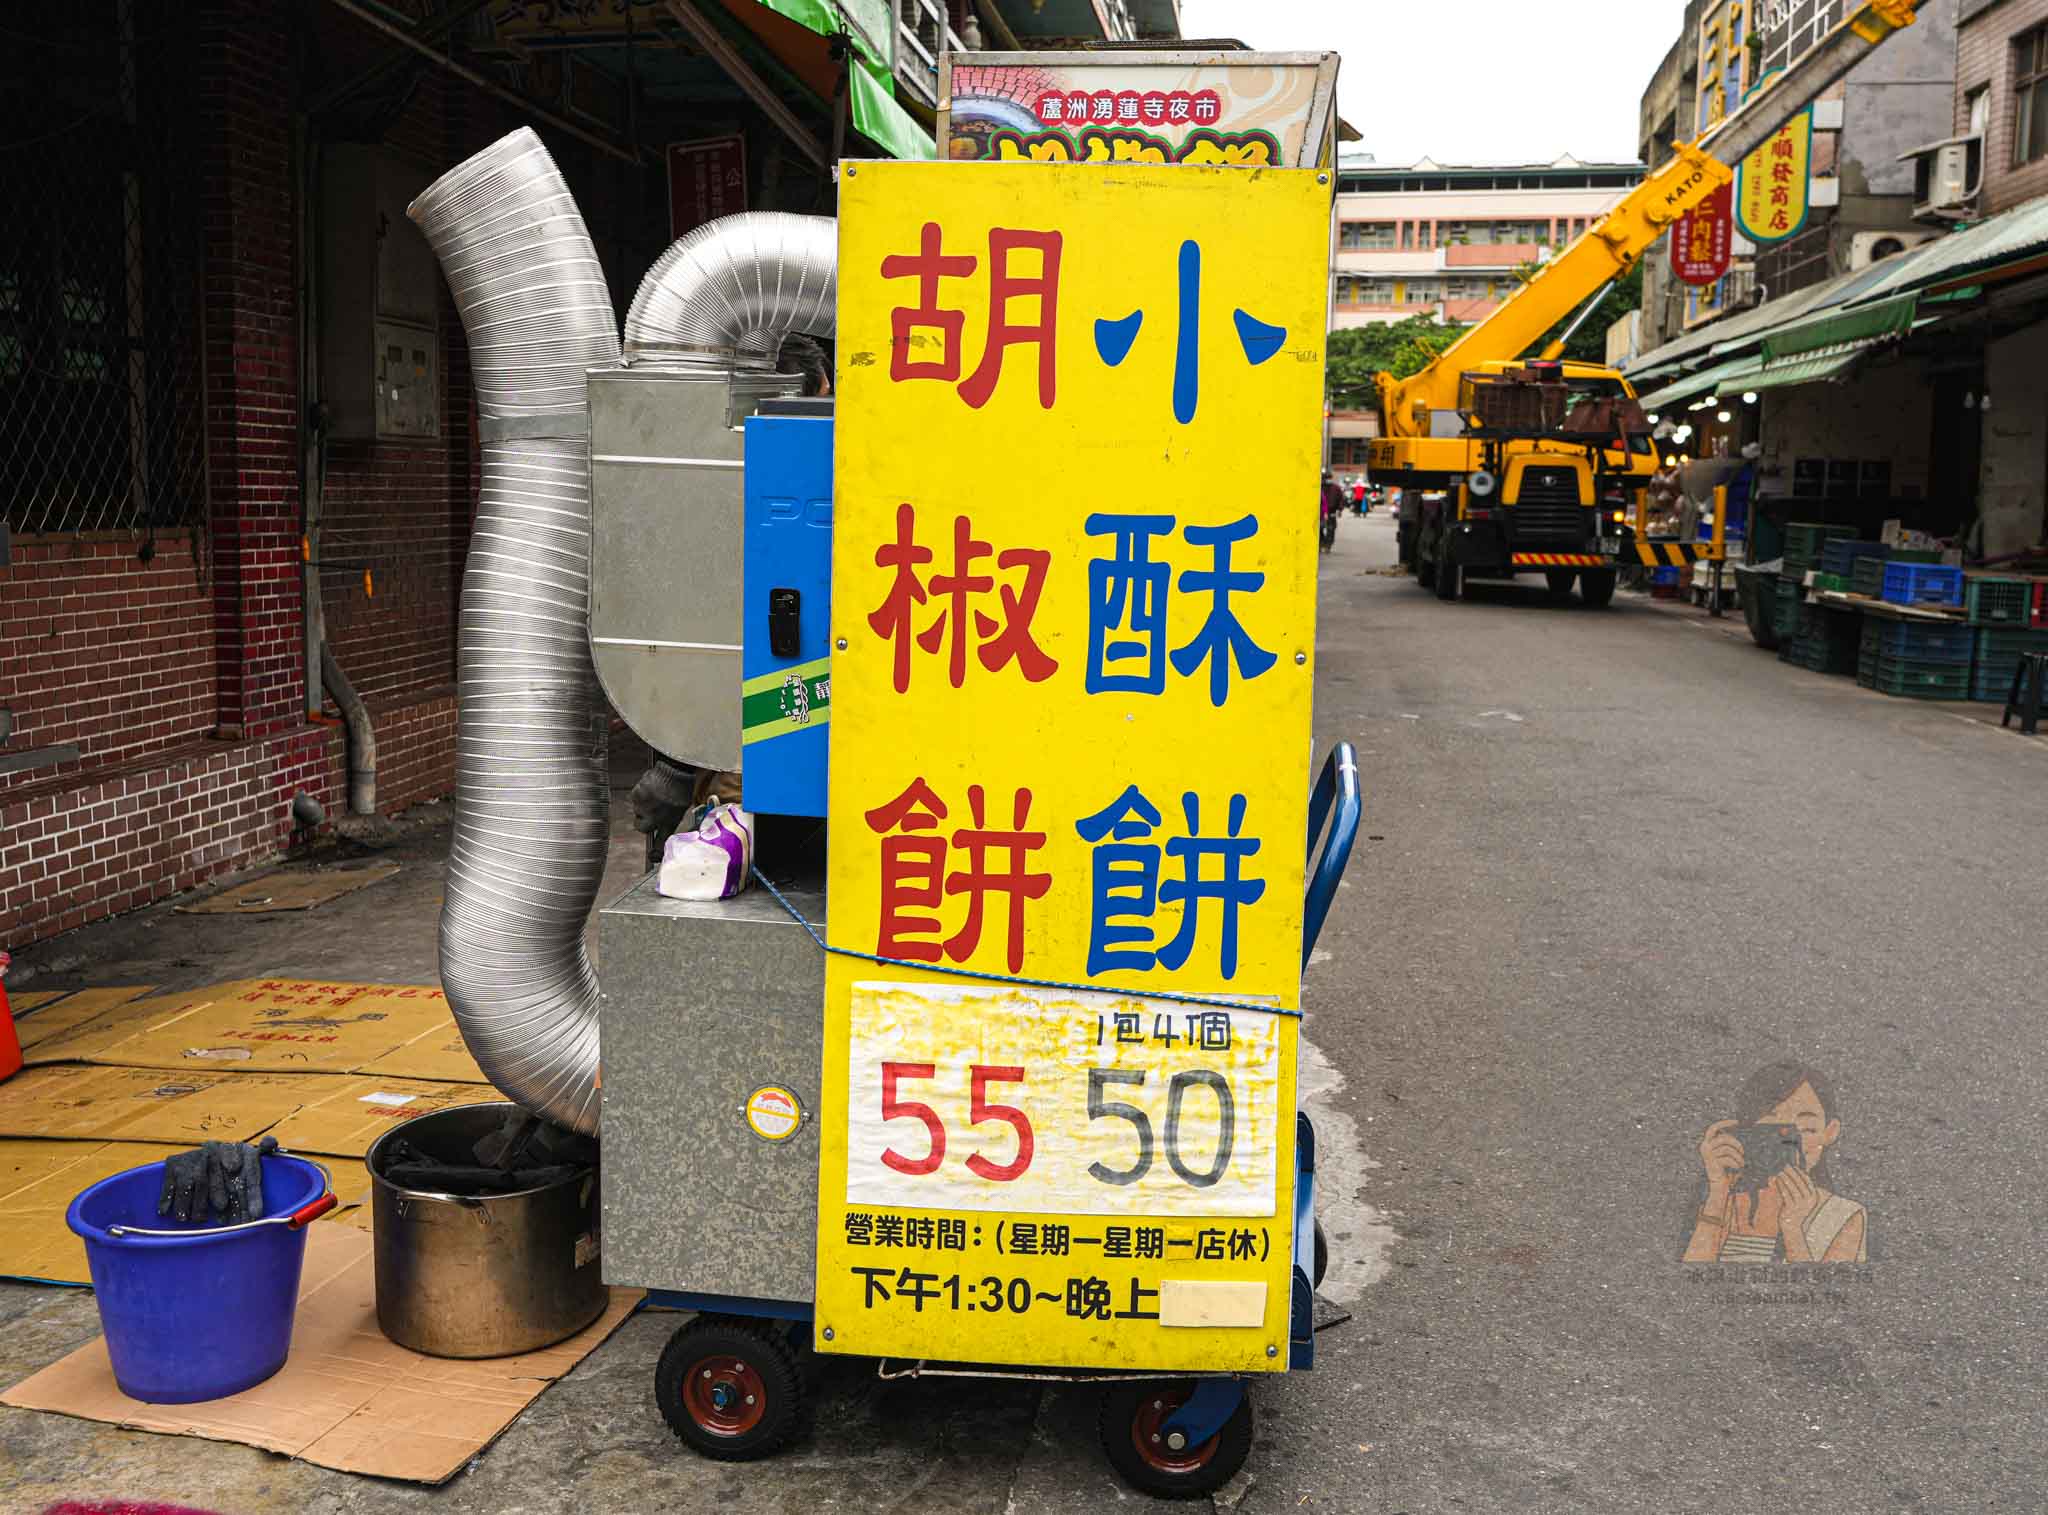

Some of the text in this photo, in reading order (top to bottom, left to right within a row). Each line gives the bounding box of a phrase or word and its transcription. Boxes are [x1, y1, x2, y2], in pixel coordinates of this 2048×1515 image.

[1041, 97, 1217, 120] 蘆洲湧蓮寺夜市
[1664, 171, 1703, 206] KATO
[866, 222, 1061, 974] 胡椒餅
[1076, 240, 1287, 979] 小酥餅
[1097, 1011, 1232, 1051] 1包4個
[881, 1061, 1235, 1188] 55 50
[851, 1266, 1160, 1320] 下午1:30~晚上
